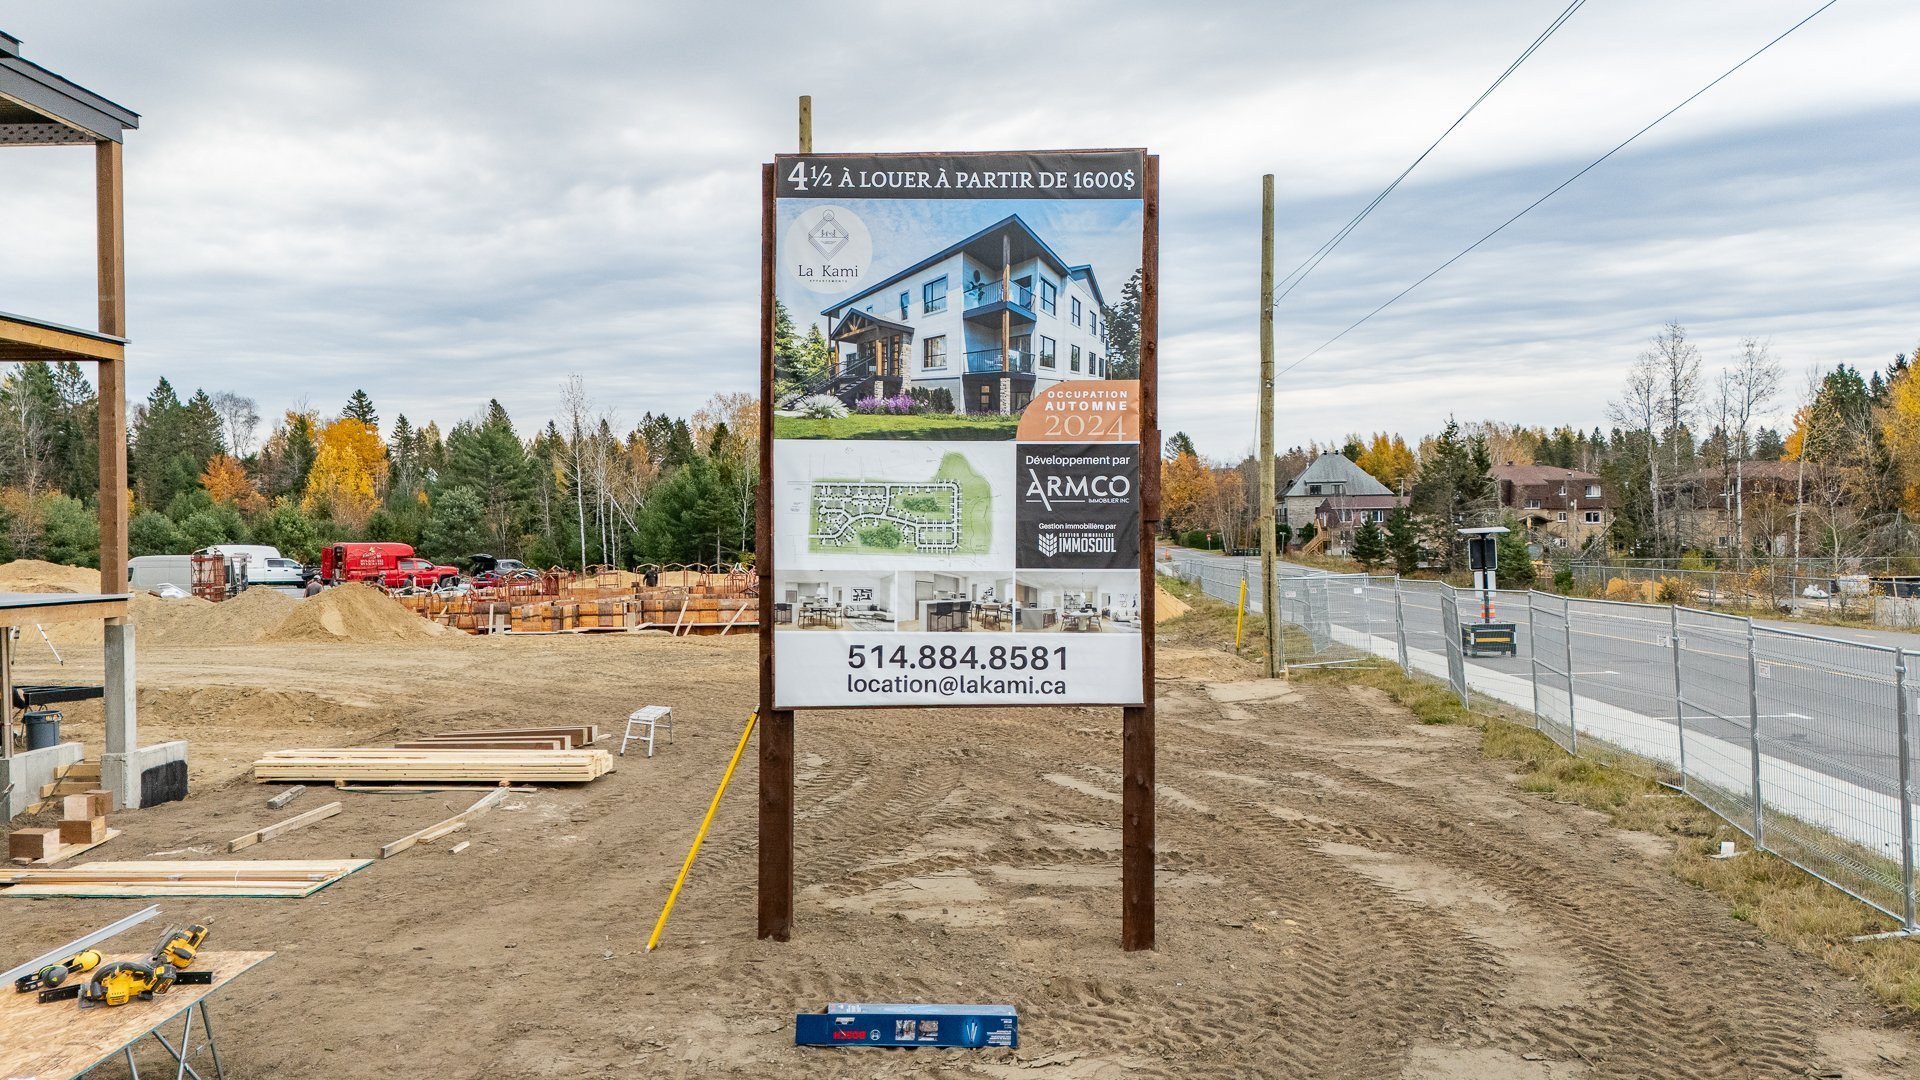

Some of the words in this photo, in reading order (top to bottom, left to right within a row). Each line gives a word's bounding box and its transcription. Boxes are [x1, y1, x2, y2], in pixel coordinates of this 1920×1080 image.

[838, 167, 855, 187] À
[859, 171, 932, 188] LOUER
[934, 168, 951, 188] À
[955, 171, 1034, 188] PARTIR
[1039, 171, 1067, 188] DE
[1073, 169, 1136, 190] 1600$
[798, 264, 813, 277] La
[822, 264, 858, 277] Kami
[1047, 390, 1128, 399] OCCUPATION
[1044, 401, 1128, 411] AUTOMNE
[1044, 415, 1127, 441] 2024
[1025, 455, 1110, 467] Développement
[1112, 456, 1131, 467] par
[1025, 468, 1131, 511] ARMCO
[1058, 537, 1117, 553] IMMOSOUL
[848, 644, 1067, 671] 514.884.8581
[847, 674, 1067, 696] location@lakami.ca
